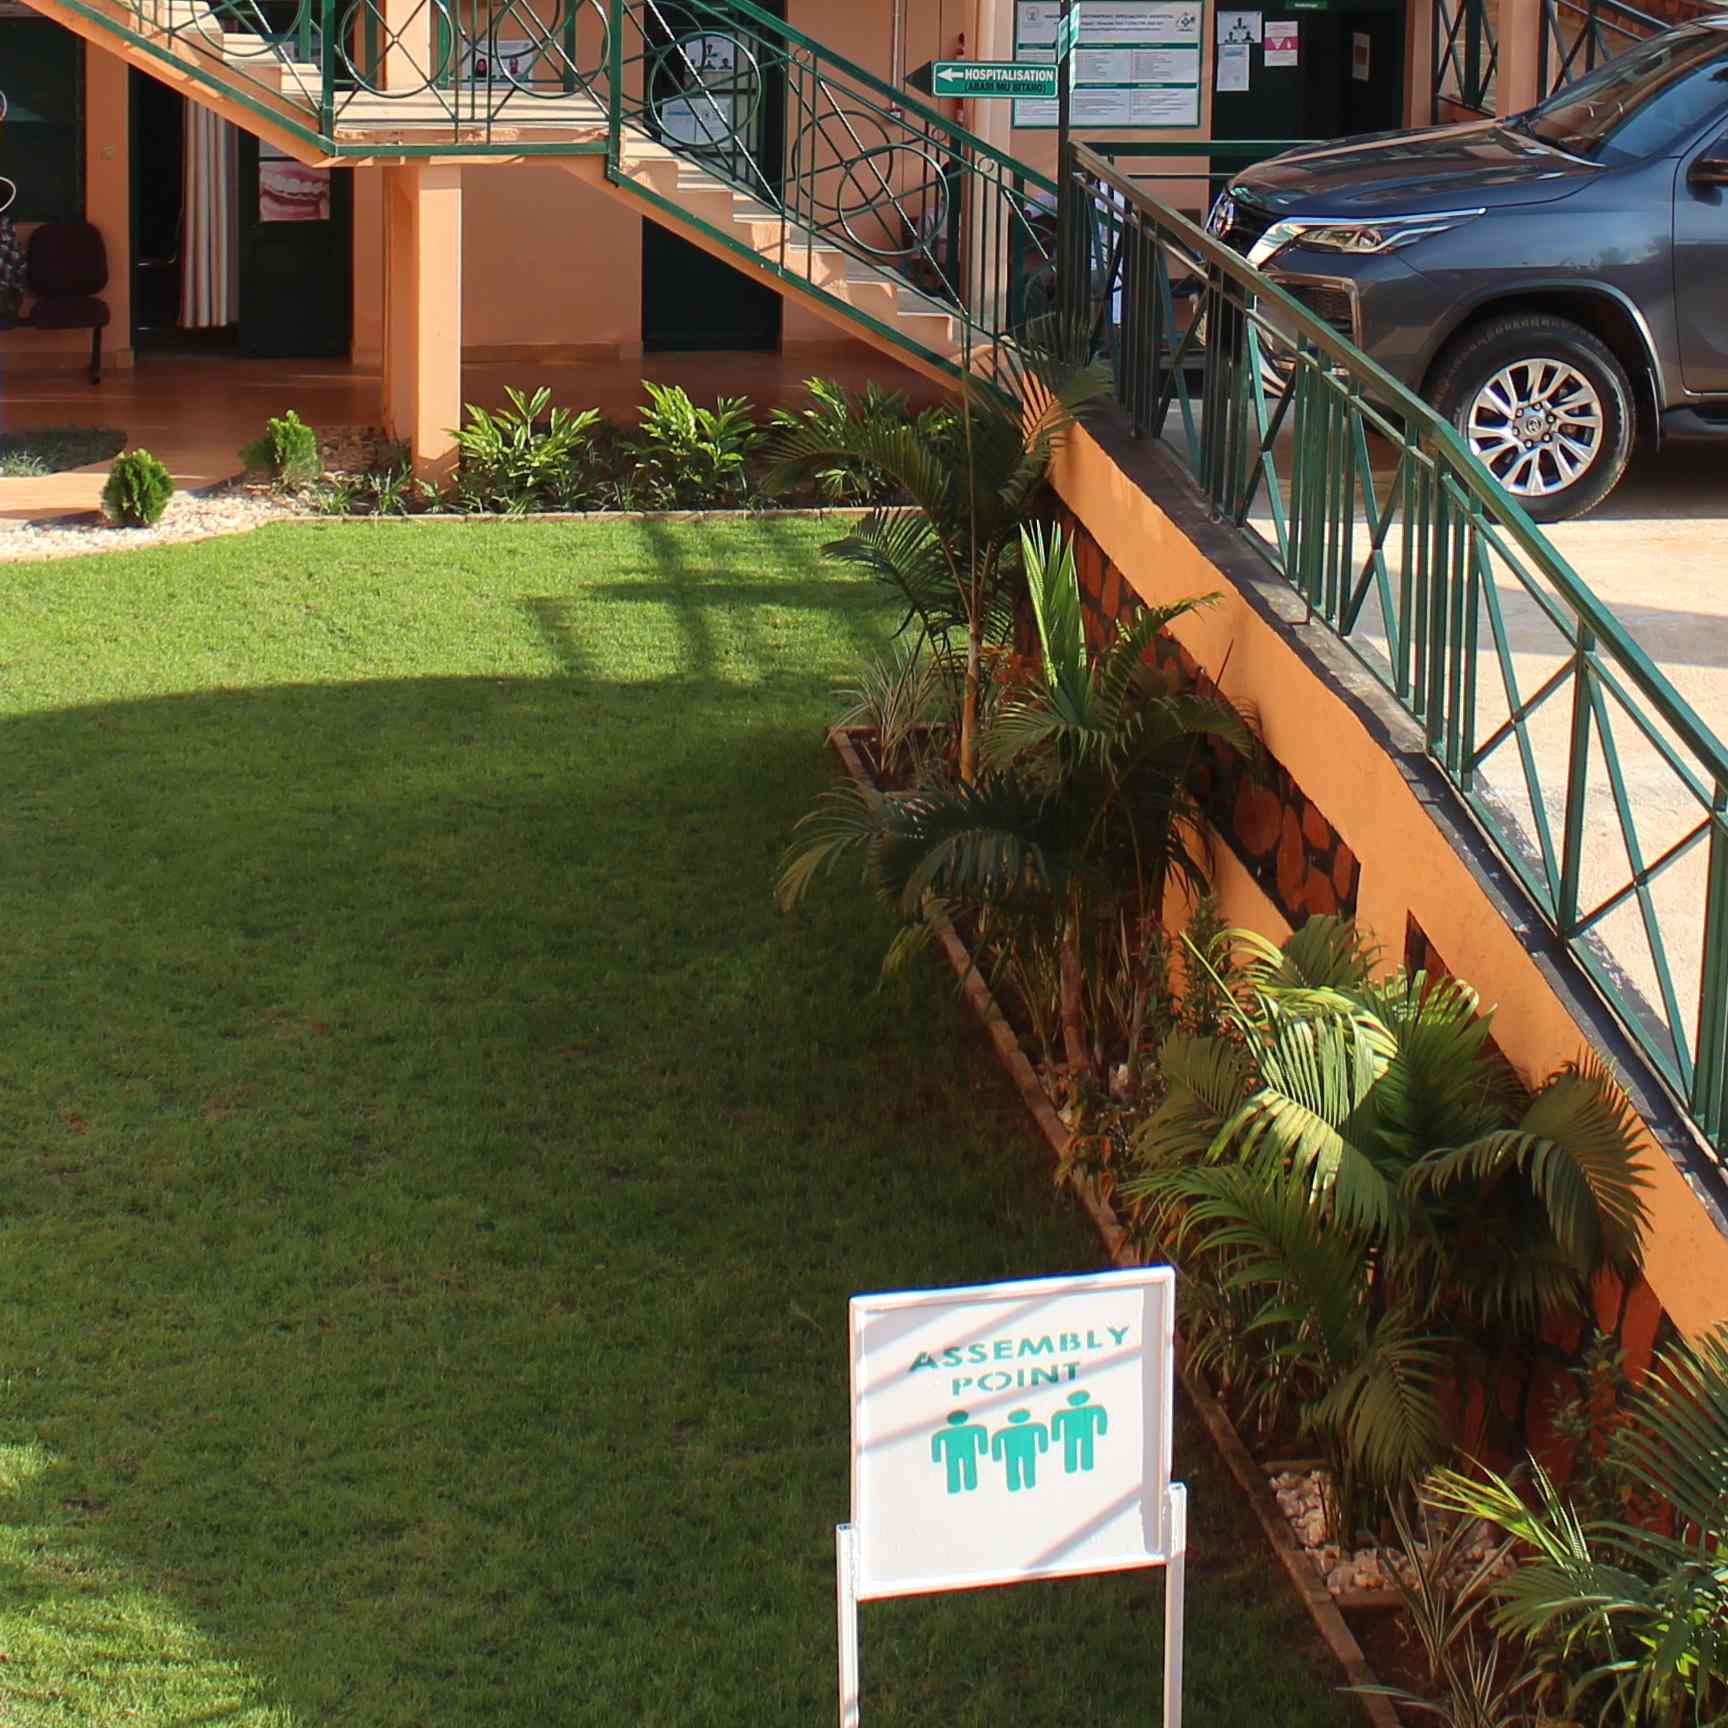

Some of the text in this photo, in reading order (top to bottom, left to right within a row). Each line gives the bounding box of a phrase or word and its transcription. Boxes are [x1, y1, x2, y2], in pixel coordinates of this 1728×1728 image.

[964, 68, 1054, 81] HOSPITALISATION
[909, 1325, 1130, 1373] ASSEMBLY
[951, 1360, 1082, 1397] POINT
